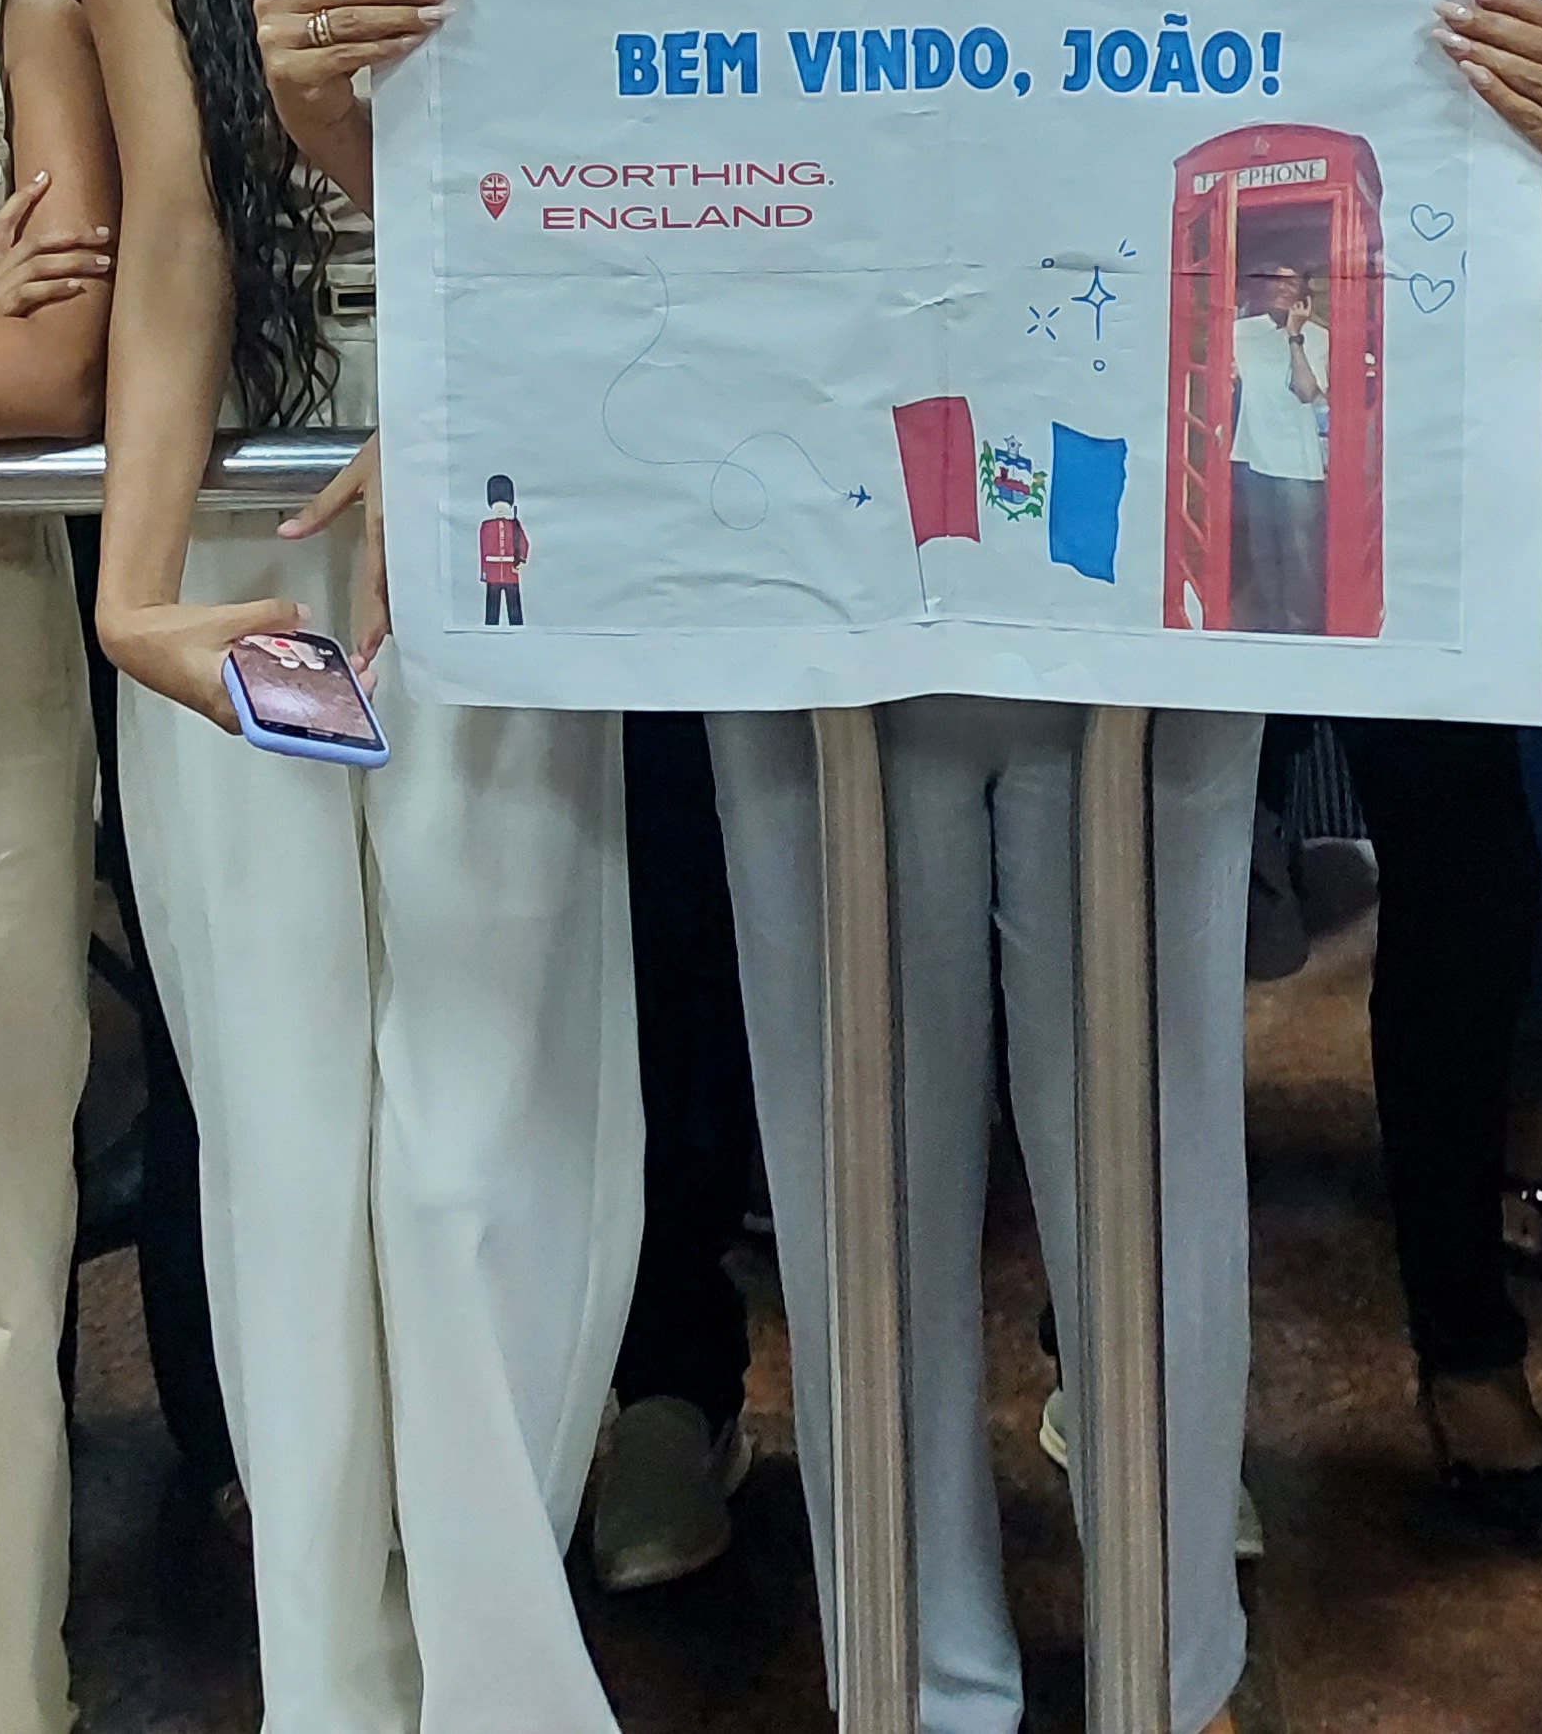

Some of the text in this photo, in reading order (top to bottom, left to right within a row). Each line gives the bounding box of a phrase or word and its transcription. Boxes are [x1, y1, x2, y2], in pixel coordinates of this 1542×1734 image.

[616, 13, 1281, 97] BEM VINDO, JOÃO!
[520, 162, 834, 188] WORTHING.
[1197, 160, 1321, 191] TEPHONE
[543, 205, 813, 230] ENGLAND
